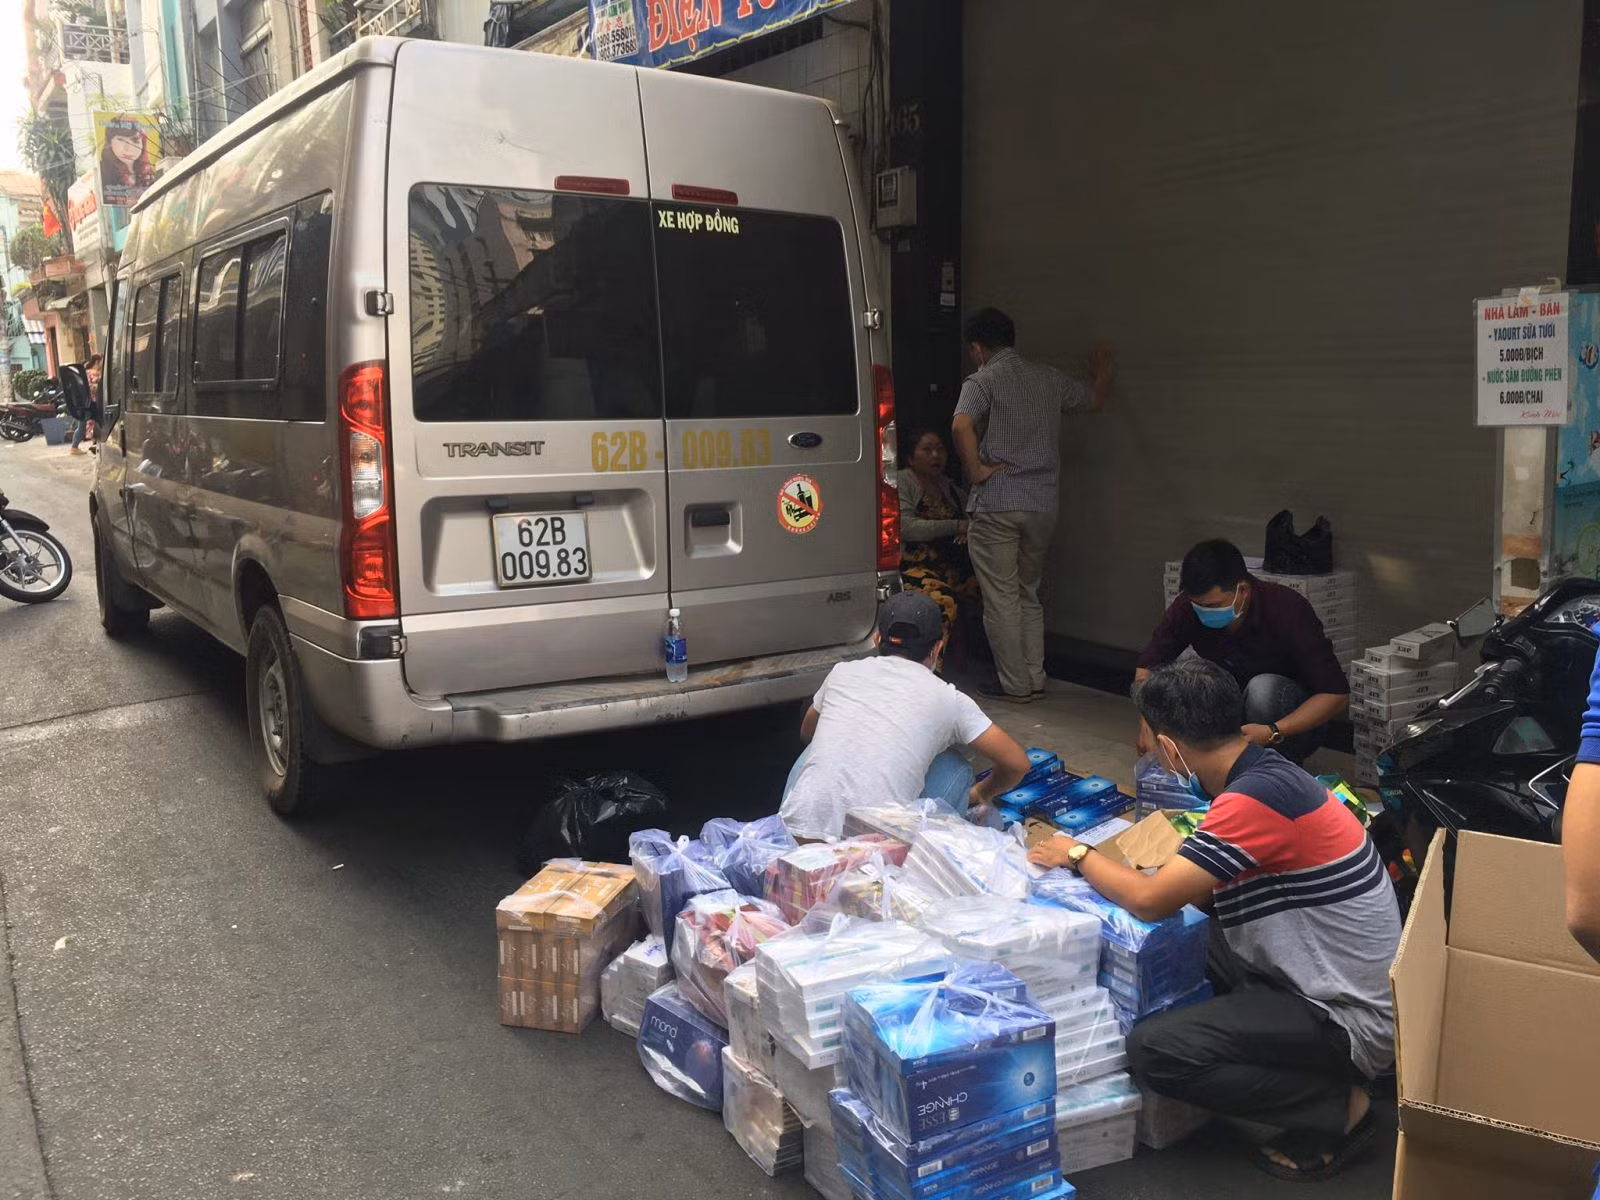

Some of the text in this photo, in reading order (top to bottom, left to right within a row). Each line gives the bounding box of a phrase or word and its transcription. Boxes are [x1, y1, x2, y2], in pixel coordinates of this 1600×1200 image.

[658, 208, 739, 234] XE HỢP ĐỒNG
[1484, 304, 1505, 320] NHÀ
[1507, 302, 1529, 319] LÀM
[1493, 326, 1521, 341] YAOURT
[443, 441, 546, 458] TRANSIT
[682, 428, 773, 469] 009.83
[517, 516, 566, 547] 62B
[501, 546, 588, 582] 009.83
[826, 591, 851, 604] ABS
[917, 1091, 968, 1116] CHANGE
